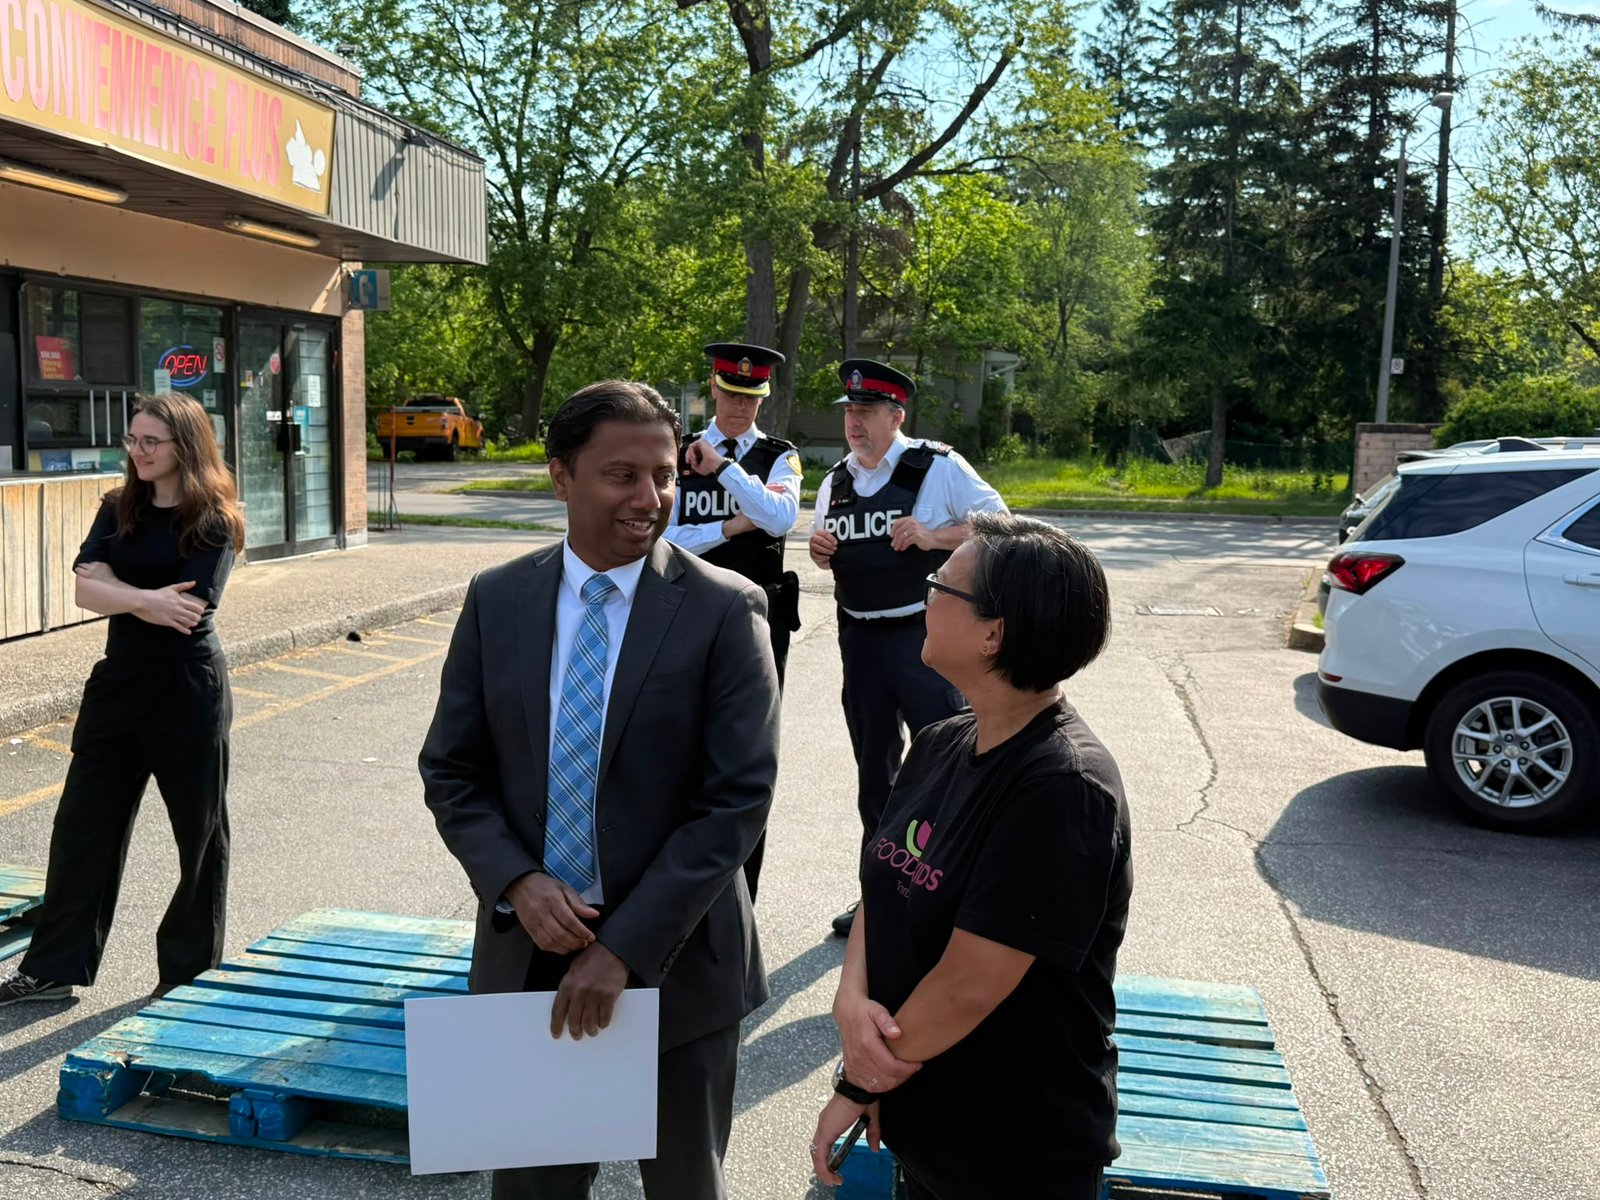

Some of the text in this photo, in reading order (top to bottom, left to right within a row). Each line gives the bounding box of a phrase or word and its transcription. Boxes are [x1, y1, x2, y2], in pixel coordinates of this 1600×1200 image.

[0, 0, 283, 186] CONVENIENCE PLUS
[163, 354, 208, 376] OPEN
[685, 490, 740, 517] POLIC
